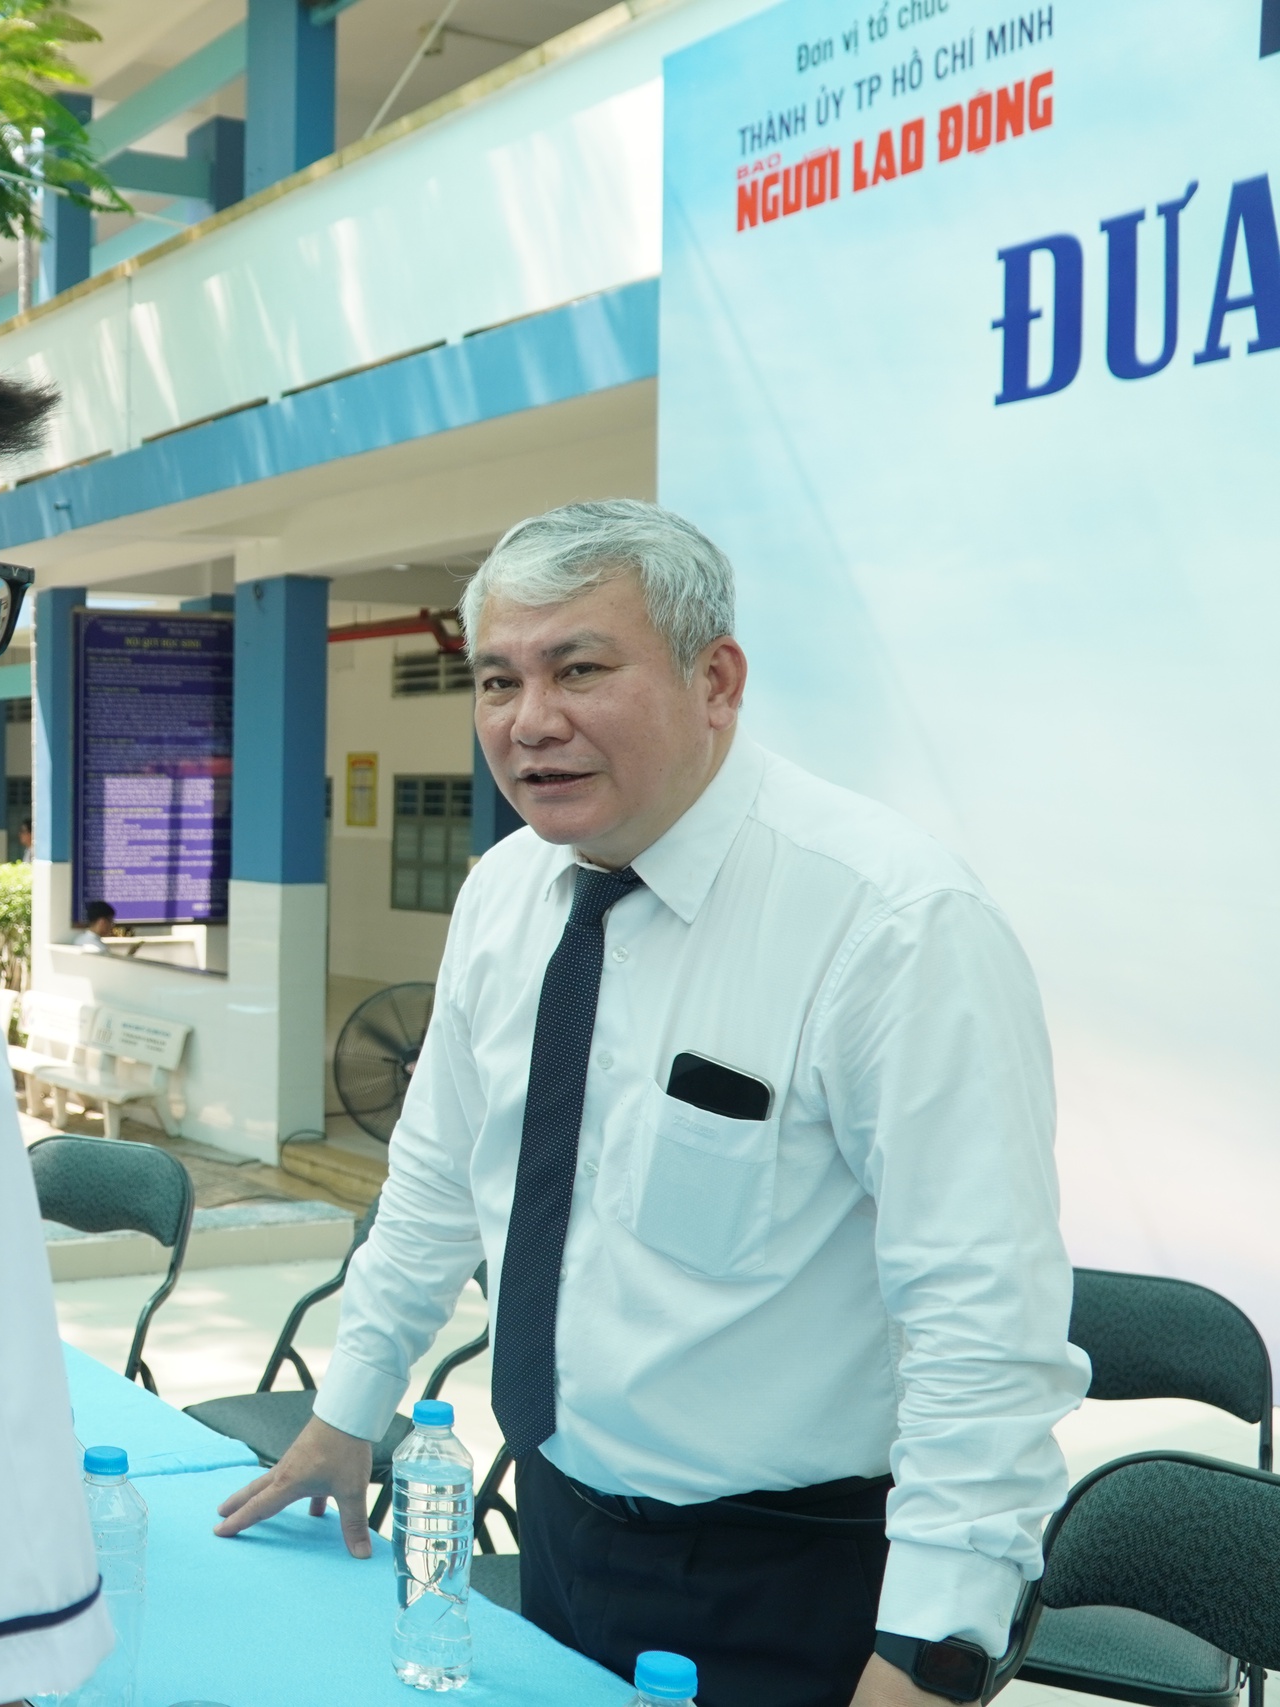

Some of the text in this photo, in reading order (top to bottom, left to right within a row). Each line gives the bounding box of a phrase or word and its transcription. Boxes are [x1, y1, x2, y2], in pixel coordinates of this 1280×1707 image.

[738, 4, 1053, 157] THÀNH ỦY TP HỒ CHÍ MINH
[842, 19, 859, 57] vị
[852, 116, 925, 193] LAO
[937, 68, 1054, 164] ĐỘNG
[991, 172, 1280, 406] ĐƯA
